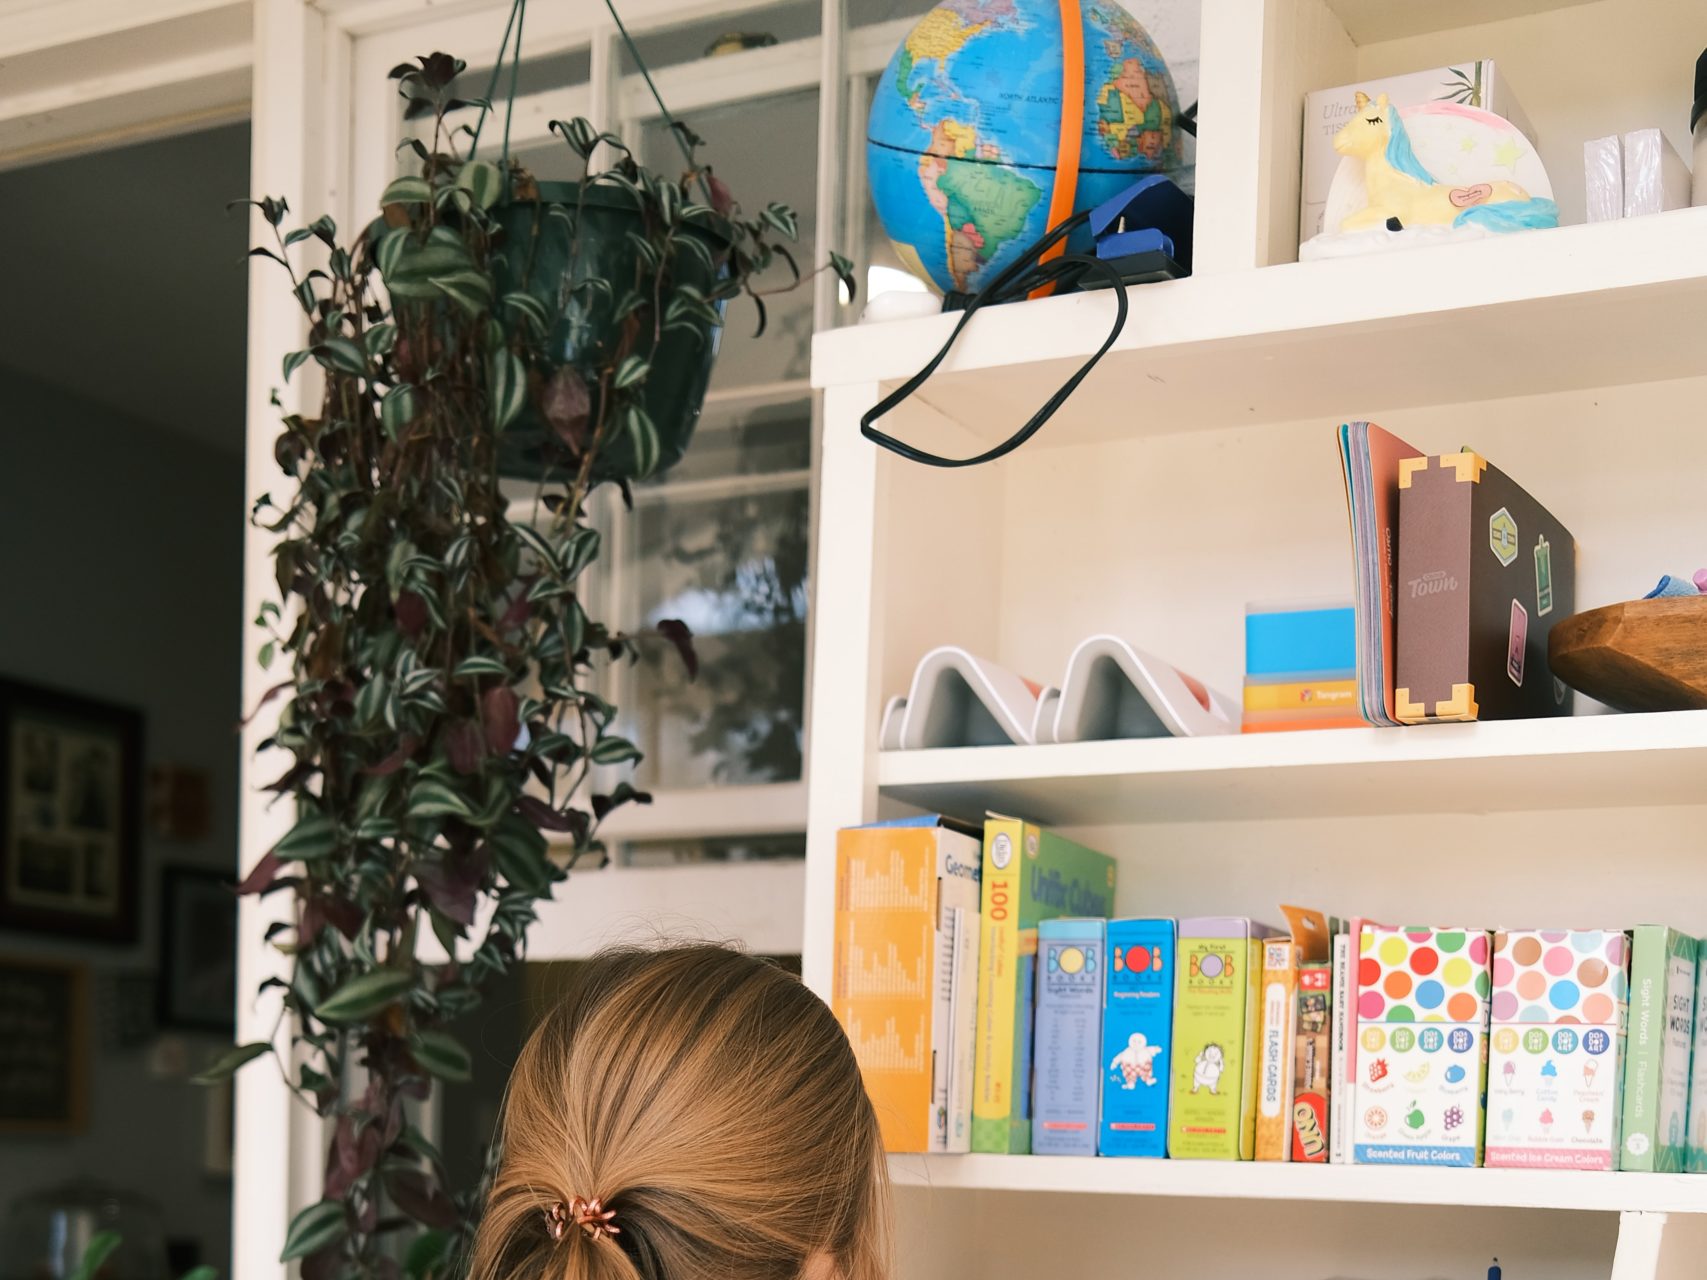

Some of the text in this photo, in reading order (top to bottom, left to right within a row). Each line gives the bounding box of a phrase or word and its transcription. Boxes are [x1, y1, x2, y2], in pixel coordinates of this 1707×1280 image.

[1026, 95, 1060, 105] ATLANTIC
[1322, 102, 1358, 121] Ultra
[1408, 576, 1458, 599] Town
[1317, 689, 1352, 700] Tangram
[990, 881, 1008, 921] 100
[1047, 945, 1097, 975] BOB
[1113, 945, 1163, 974] BOB
[1189, 953, 1235, 978] BOB
[1047, 975, 1096, 983] BOOKS
[1673, 994, 1690, 1012] SIGHT
[1669, 1015, 1690, 1035] WORDS
[1268, 1029, 1280, 1061] FLASH
[1635, 978, 1652, 1119] Sight Words Flashcards
[1266, 1062, 1278, 1103] CARDS
[1294, 1101, 1326, 1158] UNO
[1366, 1147, 1461, 1161] Scented Fruit Colors
[1490, 1151, 1604, 1165] Scented Ice Cream Colors
